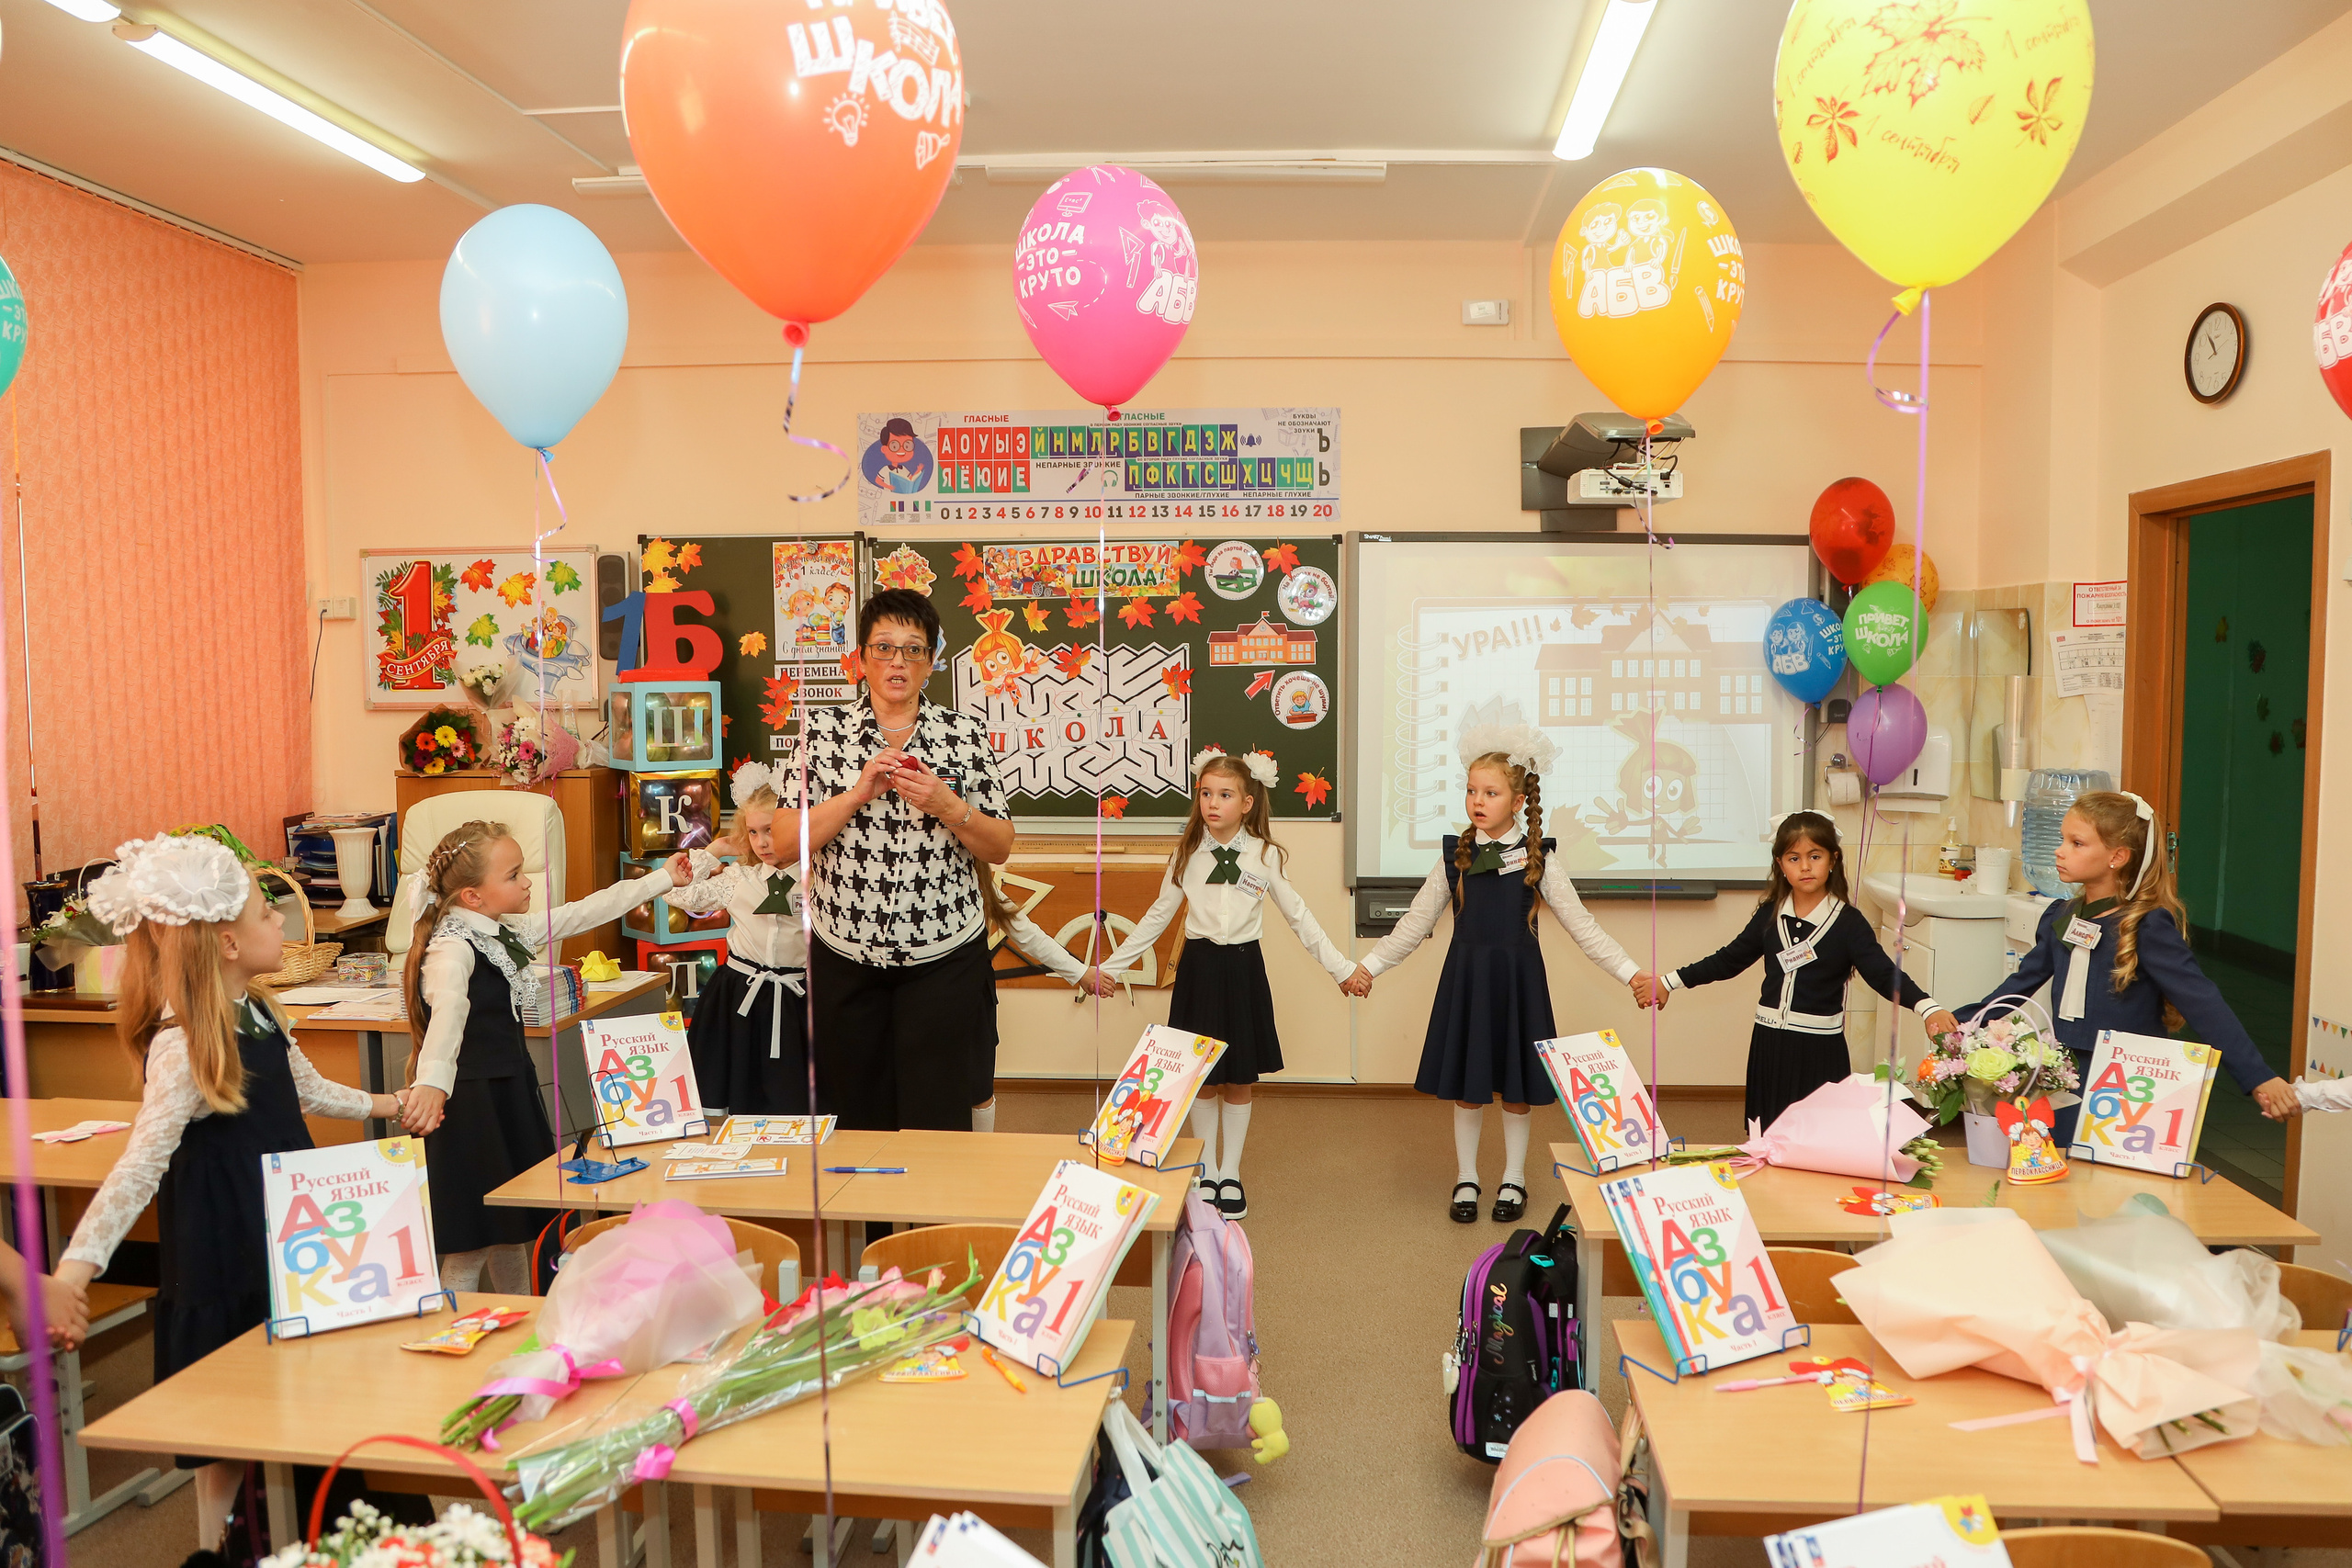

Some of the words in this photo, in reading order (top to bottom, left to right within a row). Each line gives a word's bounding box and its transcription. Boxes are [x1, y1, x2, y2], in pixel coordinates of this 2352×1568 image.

[1015, 221, 1085, 263] ШКОЛА
[1019, 266, 1081, 299] КРУТО
[1577, 264, 1672, 319] АБВ
[1136, 269, 1197, 324] АБВ
[964, 414, 1010, 423] ГЛАСНЫЕ
[1120, 412, 1165, 421] ГЛАСНЫЕ
[941, 434, 953, 455] А
[960, 434, 970, 455] О
[978, 434, 989, 454] У
[996, 434, 1009, 454] Ы
[1016, 433, 1025, 454] Э
[1035, 427, 1045, 453] Й
[1054, 433, 1063, 453] Н
[1071, 433, 1083, 453] М
[1091, 432, 1102, 452] Л
[1110, 432, 1120, 451] Р
[1128, 432, 1139, 452] Б
[1148, 431, 1159, 452] В
[1167, 431, 1176, 451] Г
[1184, 429, 1196, 452] Д
[1204, 430, 1215, 451] З
[1220, 431, 1237, 451] Ж
[941, 468, 952, 489] Я
[960, 465, 970, 490] Ё
[977, 467, 991, 488] Ю
[997, 467, 1008, 487] И
[1016, 466, 1025, 486] Е
[1128, 465, 1139, 485] П
[1147, 464, 1159, 485] Ф
[1166, 465, 1177, 485] К
[1185, 464, 1195, 484] Т
[1204, 464, 1215, 484] С
[1221, 464, 1237, 484] Ш
[1243, 464, 1253, 484] Х
[1261, 463, 1272, 487] Ц
[1280, 463, 1291, 483] Ч
[1295, 462, 1313, 486] Щ
[941, 507, 950, 520] 0
[956, 507, 963, 519] 1
[967, 507, 978, 519] 2
[982, 507, 991, 519] 3
[996, 507, 1007, 518] 4
[1012, 507, 1021, 519] 5
[1025, 506, 1035, 519] 6
[1041, 506, 1050, 518] 7
[1054, 506, 1064, 518] 8
[1069, 506, 1079, 518] 9
[1084, 506, 1102, 518] 10
[1107, 505, 1124, 518] 11
[1128, 505, 1147, 518] 12
[1151, 505, 1170, 518] 13
[1174, 504, 1193, 517] 14
[1198, 504, 1216, 517] 15
[1221, 504, 1239, 517] 16
[1245, 504, 1262, 517] 17
[1267, 504, 1285, 517] 18
[1290, 504, 1307, 517] 19
[1313, 504, 1333, 517] 20
[809, 567, 841, 578] класс!
[1071, 568, 1166, 589] ШКОЛА!
[389, 560, 447, 691] 1
[1451, 615, 1545, 661] УРА!!!
[1855, 626, 1909, 648] ШКОЛА
[386, 640, 449, 676] СЕНТЯБРЯ
[1772, 653, 1811, 675] АБВ
[780, 667, 846, 678] ПЕРЕМЕНА
[792, 687, 842, 698] ЗВОНОК
[649, 706, 708, 748] Ш
[655, 795, 693, 835] К
[600, 1032, 656, 1048] Русский
[1145, 1038, 1182, 1060] Русский
[1562, 1050, 1605, 1067] Русский
[2110, 1046, 2171, 1067] Русский
[670, 1074, 696, 1113] 1
[1144, 1100, 1173, 1139] 1
[1631, 1091, 1659, 1132] 1
[2159, 1108, 2184, 1147] 1
[2011, 1160, 2064, 1175] ПЕРВОКЛАССНИЦА
[2109, 1151, 2131, 1160] Часть
[289, 1167, 371, 1192] Русский
[1053, 1185, 1101, 1218] Русский
[1653, 1192, 1715, 1218] Русский
[388, 1224, 424, 1280] 1
[397, 1276, 424, 1287] класс
[1746, 1255, 1785, 1314] 1
[336, 1307, 366, 1318] Часть
[1045, 1280, 1084, 1337] 1
[1767, 1311, 1786, 1321] класс
[1485, 1282, 1514, 1365] Magical
[1730, 1341, 1751, 1353] Часть
